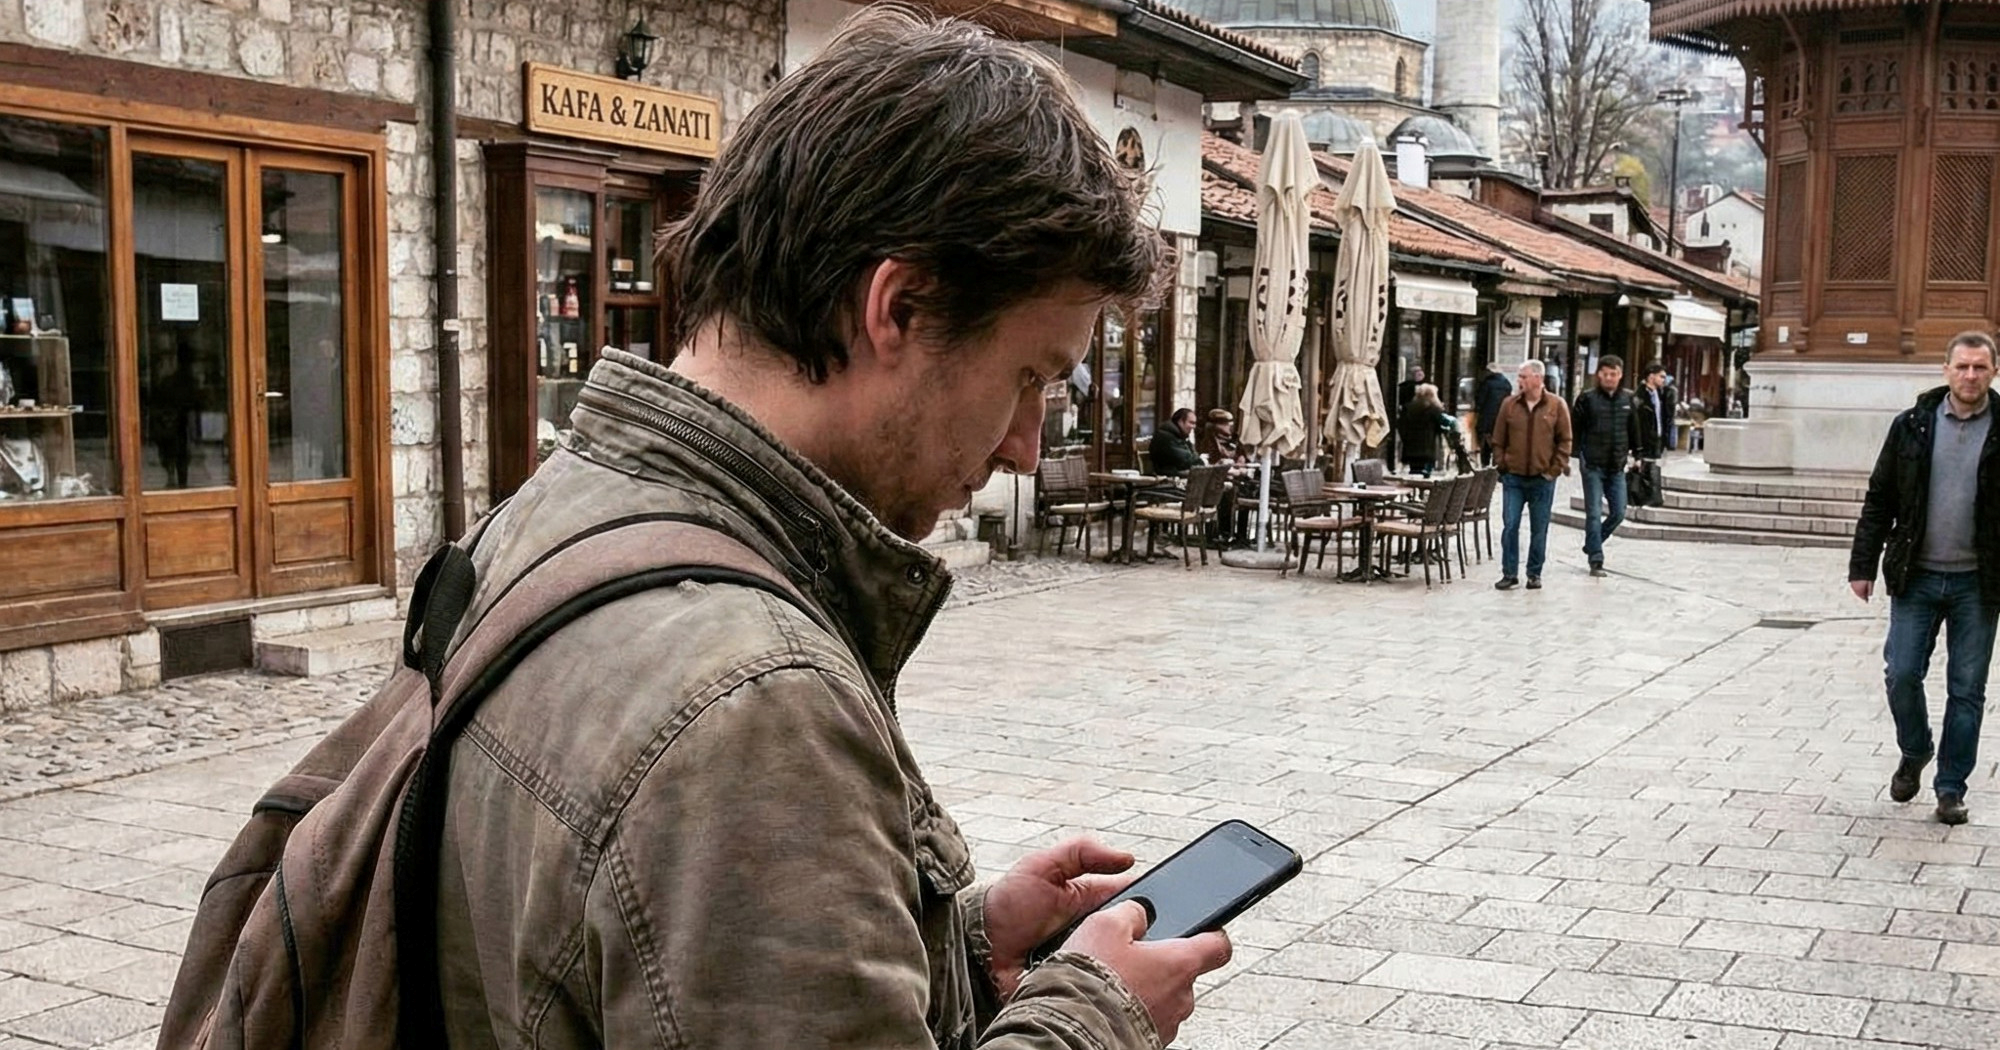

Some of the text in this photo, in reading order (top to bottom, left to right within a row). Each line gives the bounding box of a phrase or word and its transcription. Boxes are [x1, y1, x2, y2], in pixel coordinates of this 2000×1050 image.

[540, 83, 711, 141] KAFA & ZANATI
